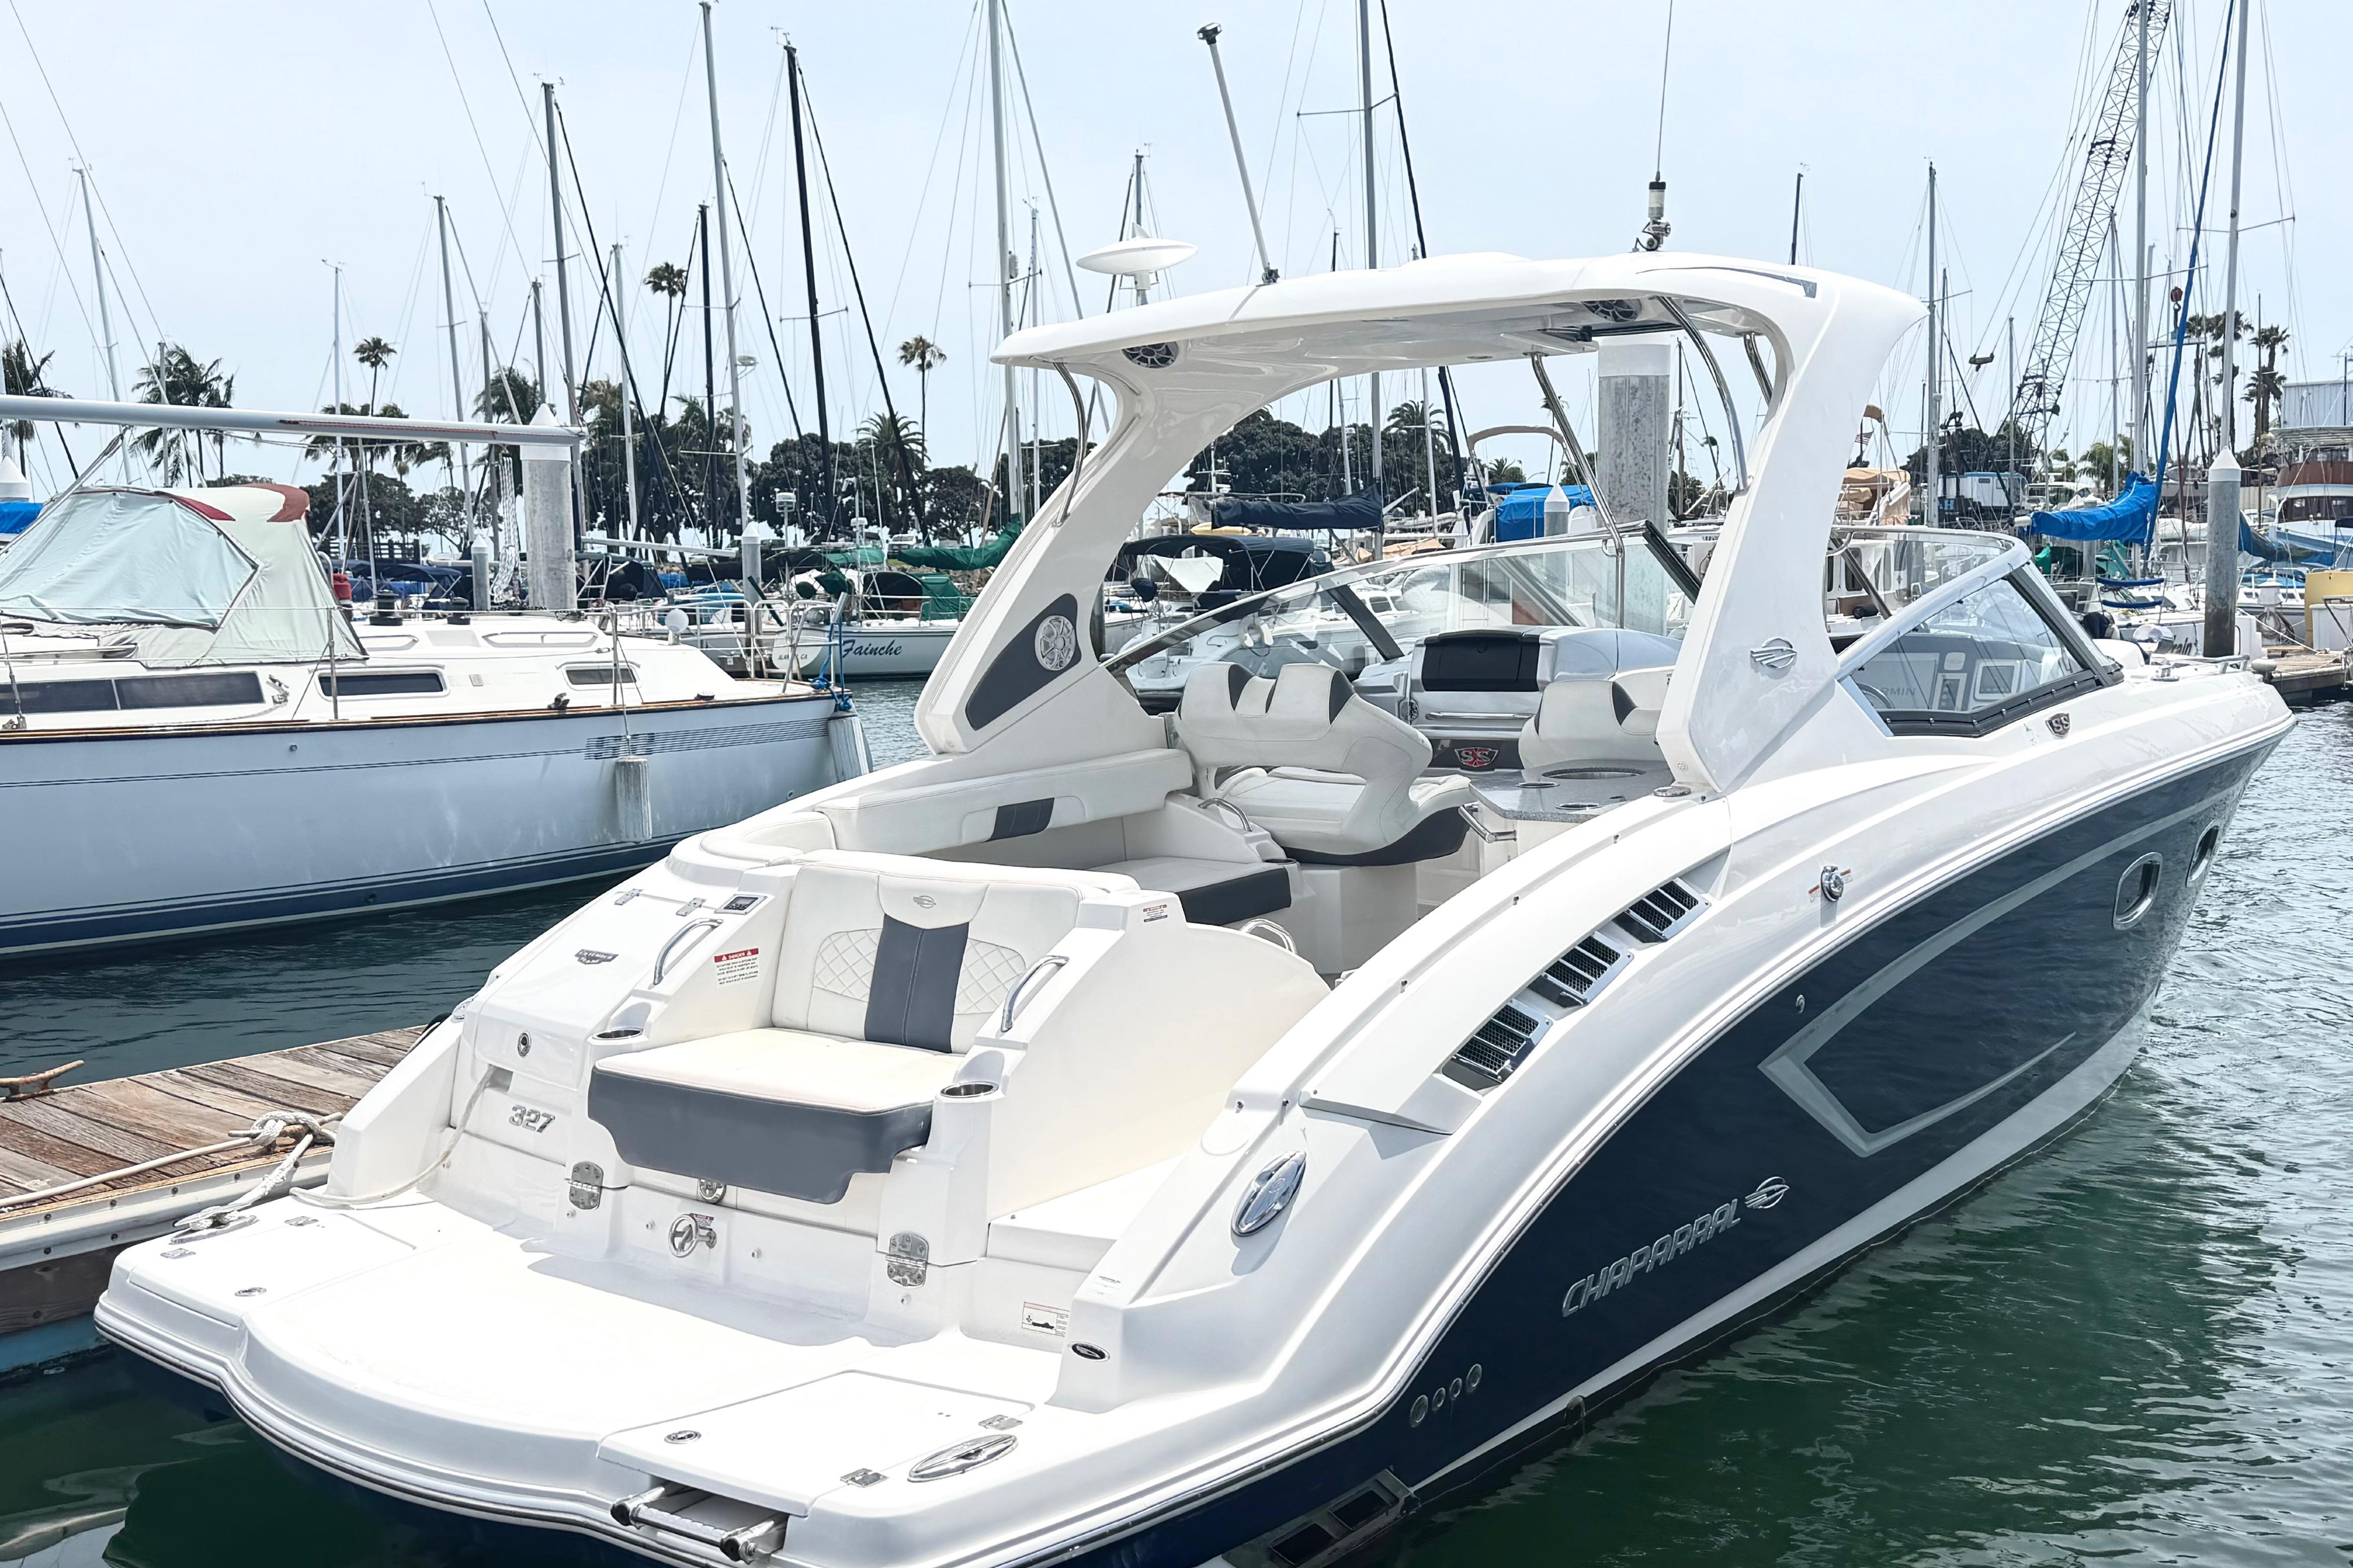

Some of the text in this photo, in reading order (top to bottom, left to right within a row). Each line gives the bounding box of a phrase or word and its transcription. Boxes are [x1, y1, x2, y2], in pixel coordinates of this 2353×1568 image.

[842, 639, 902, 658] Fainche
[509, 1104, 556, 1133] 327
[1561, 1198, 1741, 1317] CHAPARRAL
